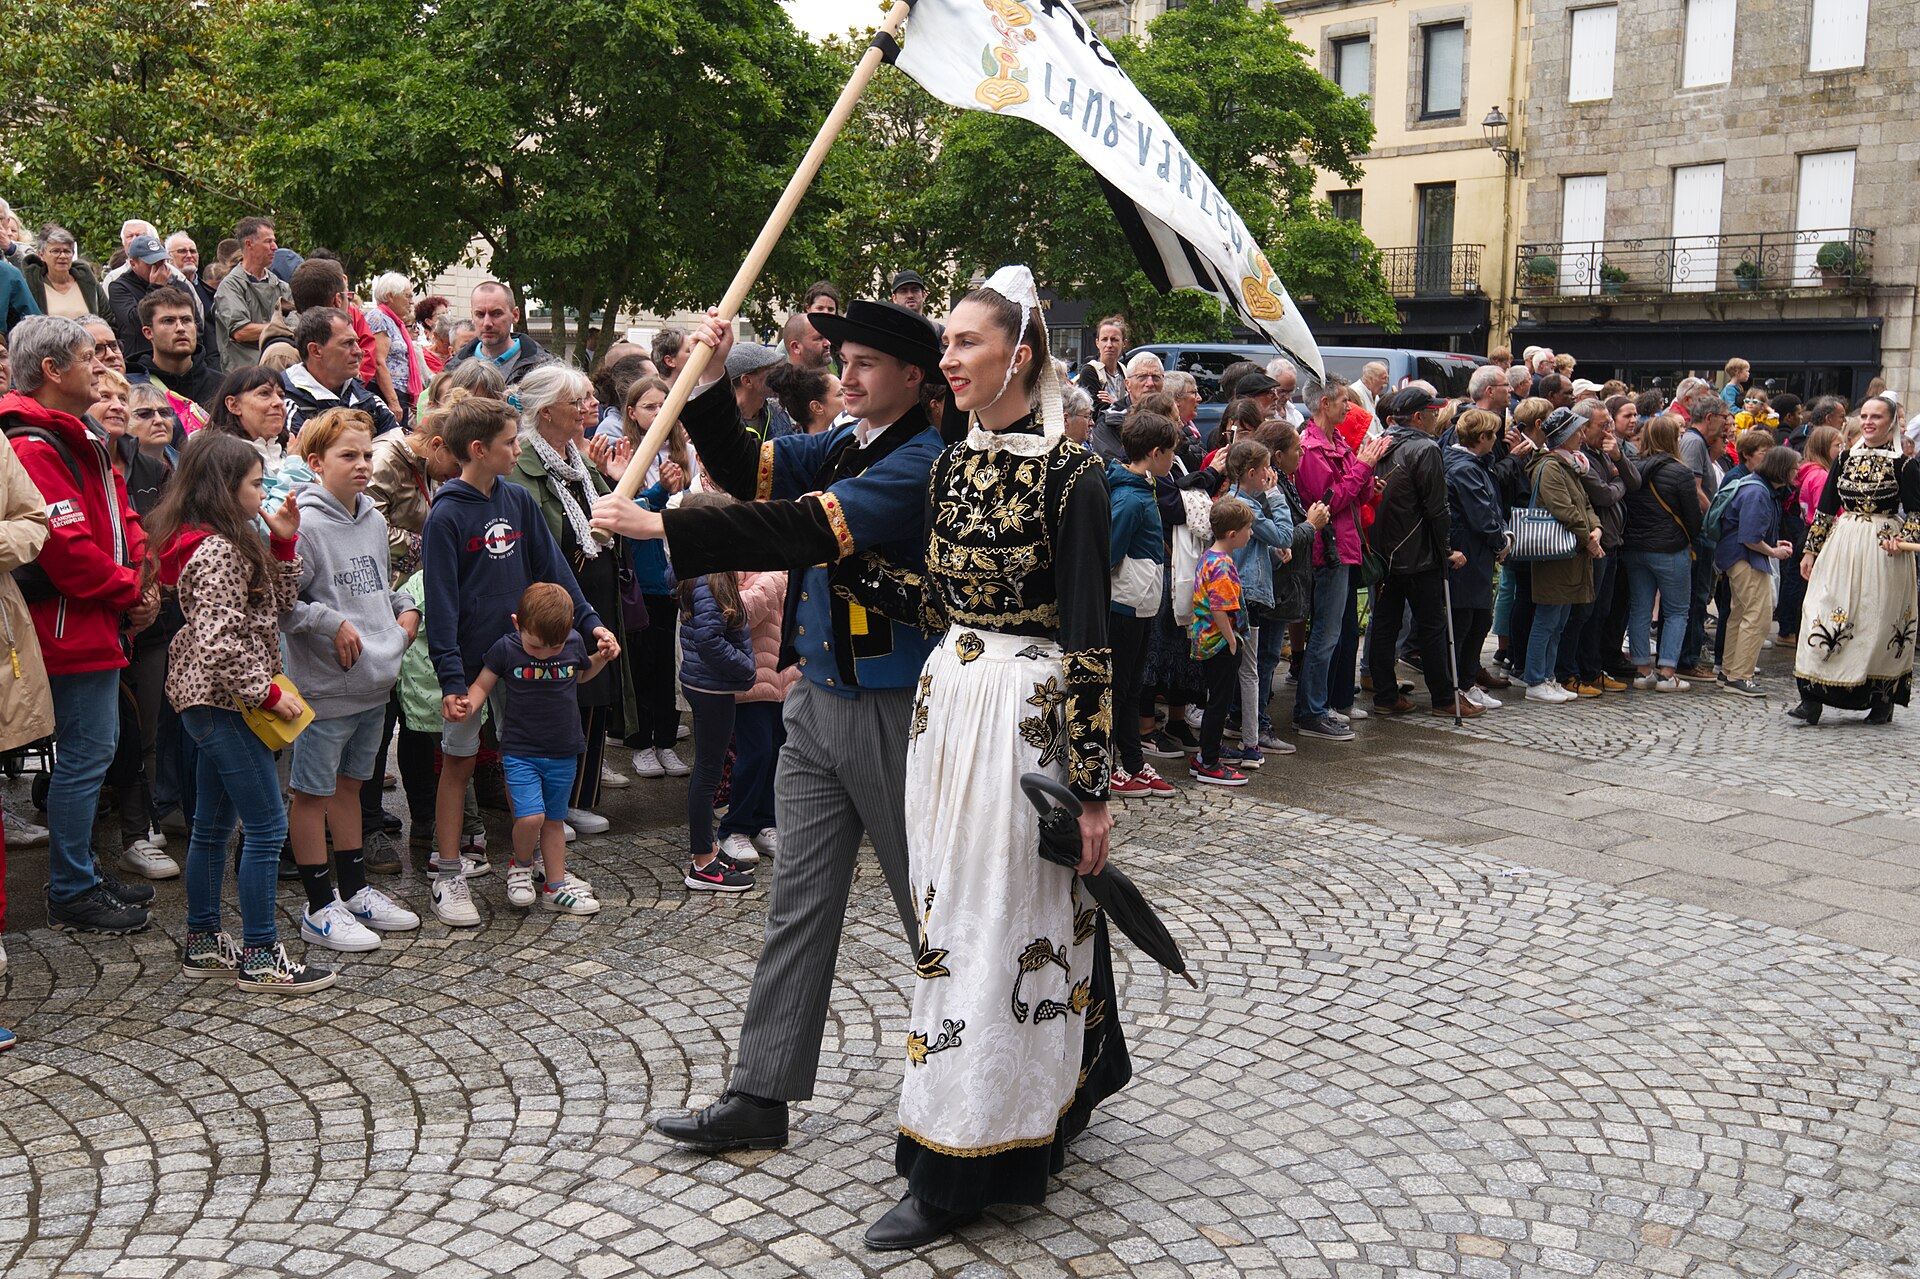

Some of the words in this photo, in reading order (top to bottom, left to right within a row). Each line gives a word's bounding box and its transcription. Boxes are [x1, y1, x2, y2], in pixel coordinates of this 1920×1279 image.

[350, 555, 370, 570] THE
[333, 569, 374, 587] NORTH
[350, 580, 376, 597] FACE
[513, 665, 574, 680] COPAINS
